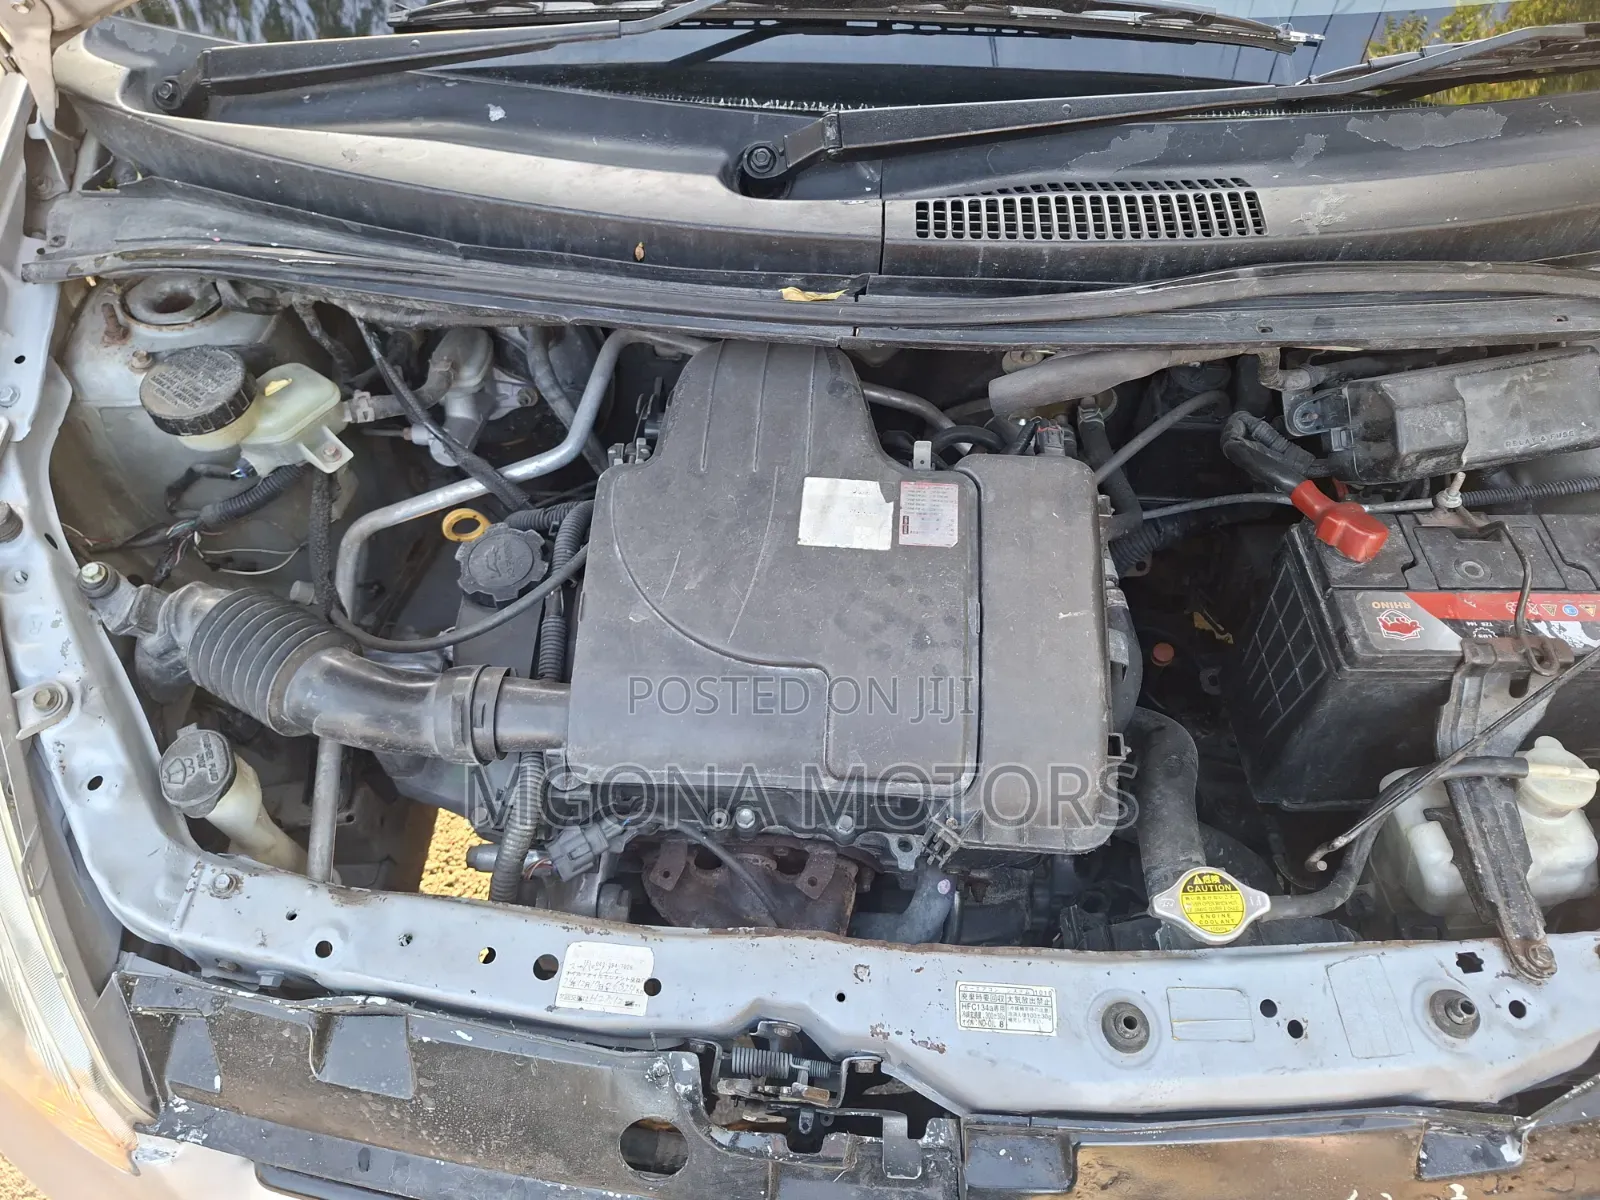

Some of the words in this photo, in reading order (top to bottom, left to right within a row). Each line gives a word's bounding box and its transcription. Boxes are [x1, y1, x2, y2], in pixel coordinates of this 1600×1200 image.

[1505, 437, 1536, 447] RELAY
[1550, 430, 1575, 440] FUSE
[1371, 601, 1411, 609] RHINO
[1187, 884, 1232, 893] CAUTION
[1007, 996, 1050, 1006] 大気放出禁止
